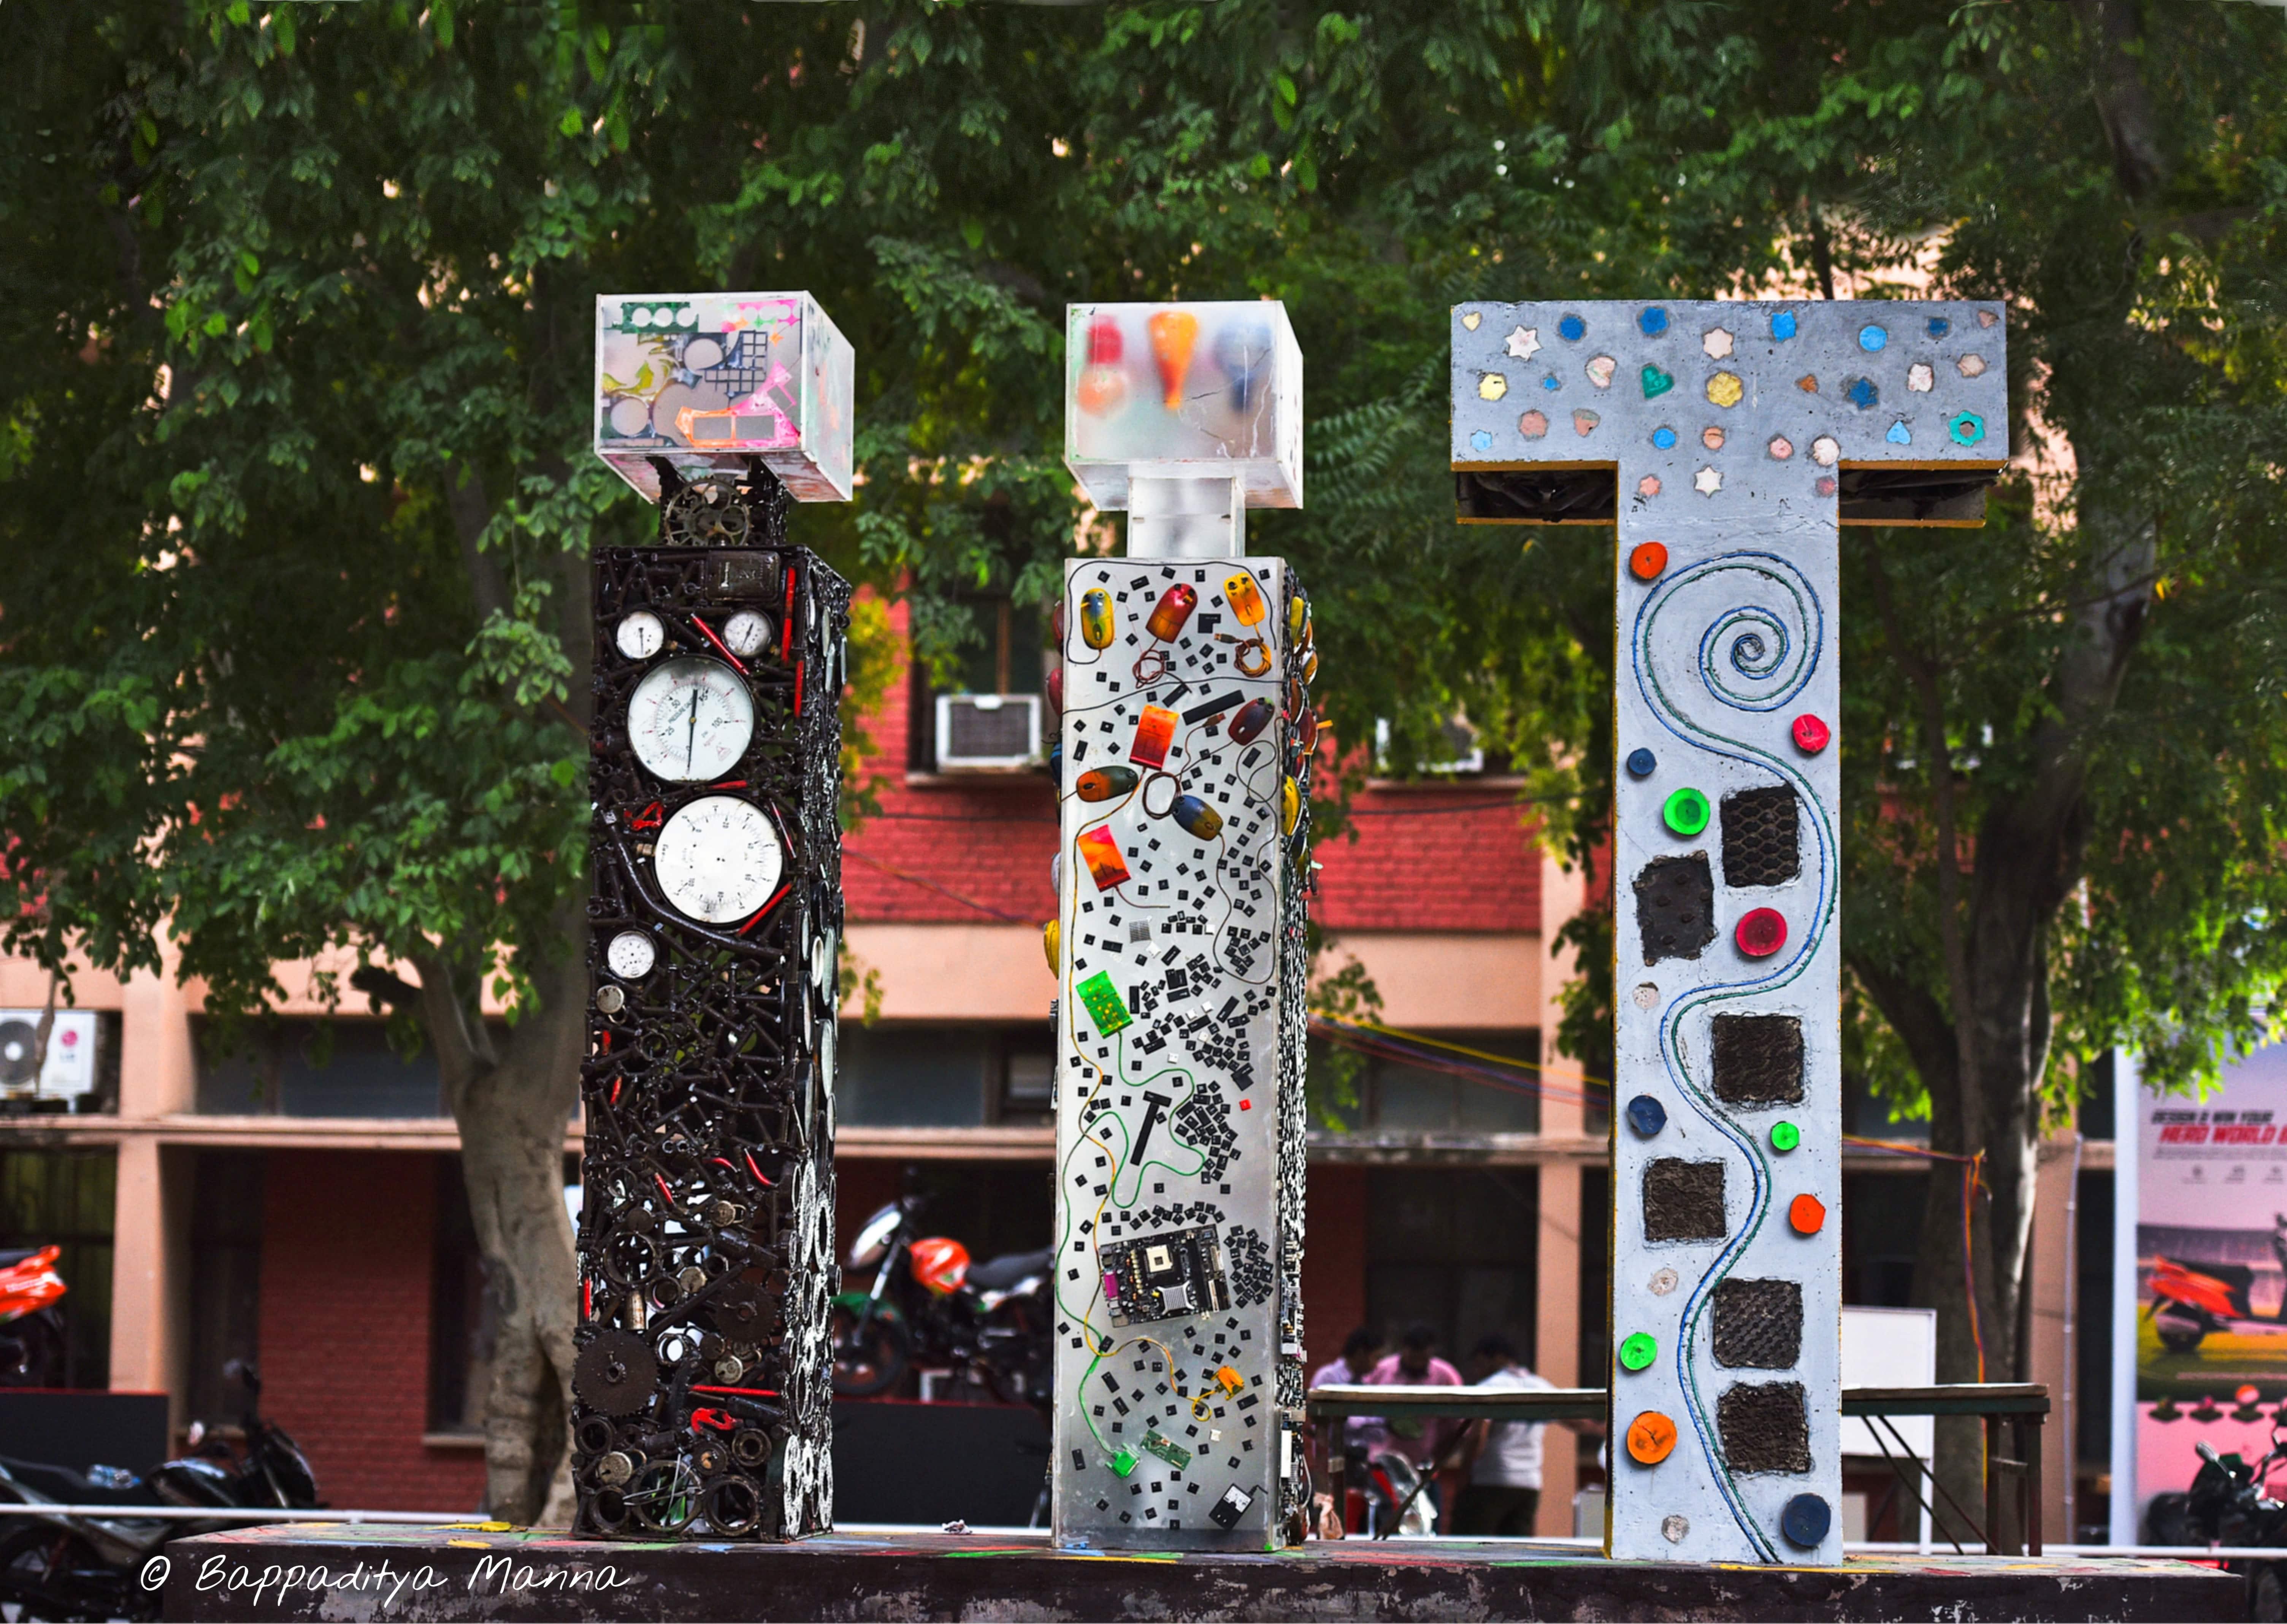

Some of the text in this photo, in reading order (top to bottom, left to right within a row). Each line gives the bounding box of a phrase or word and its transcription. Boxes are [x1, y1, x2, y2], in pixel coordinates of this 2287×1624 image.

[712, 717, 723, 728] 100
[665, 726, 675, 736] 25
[2159, 1125, 2209, 1145] HERO
[2212, 1124, 2277, 1145] WORLD
